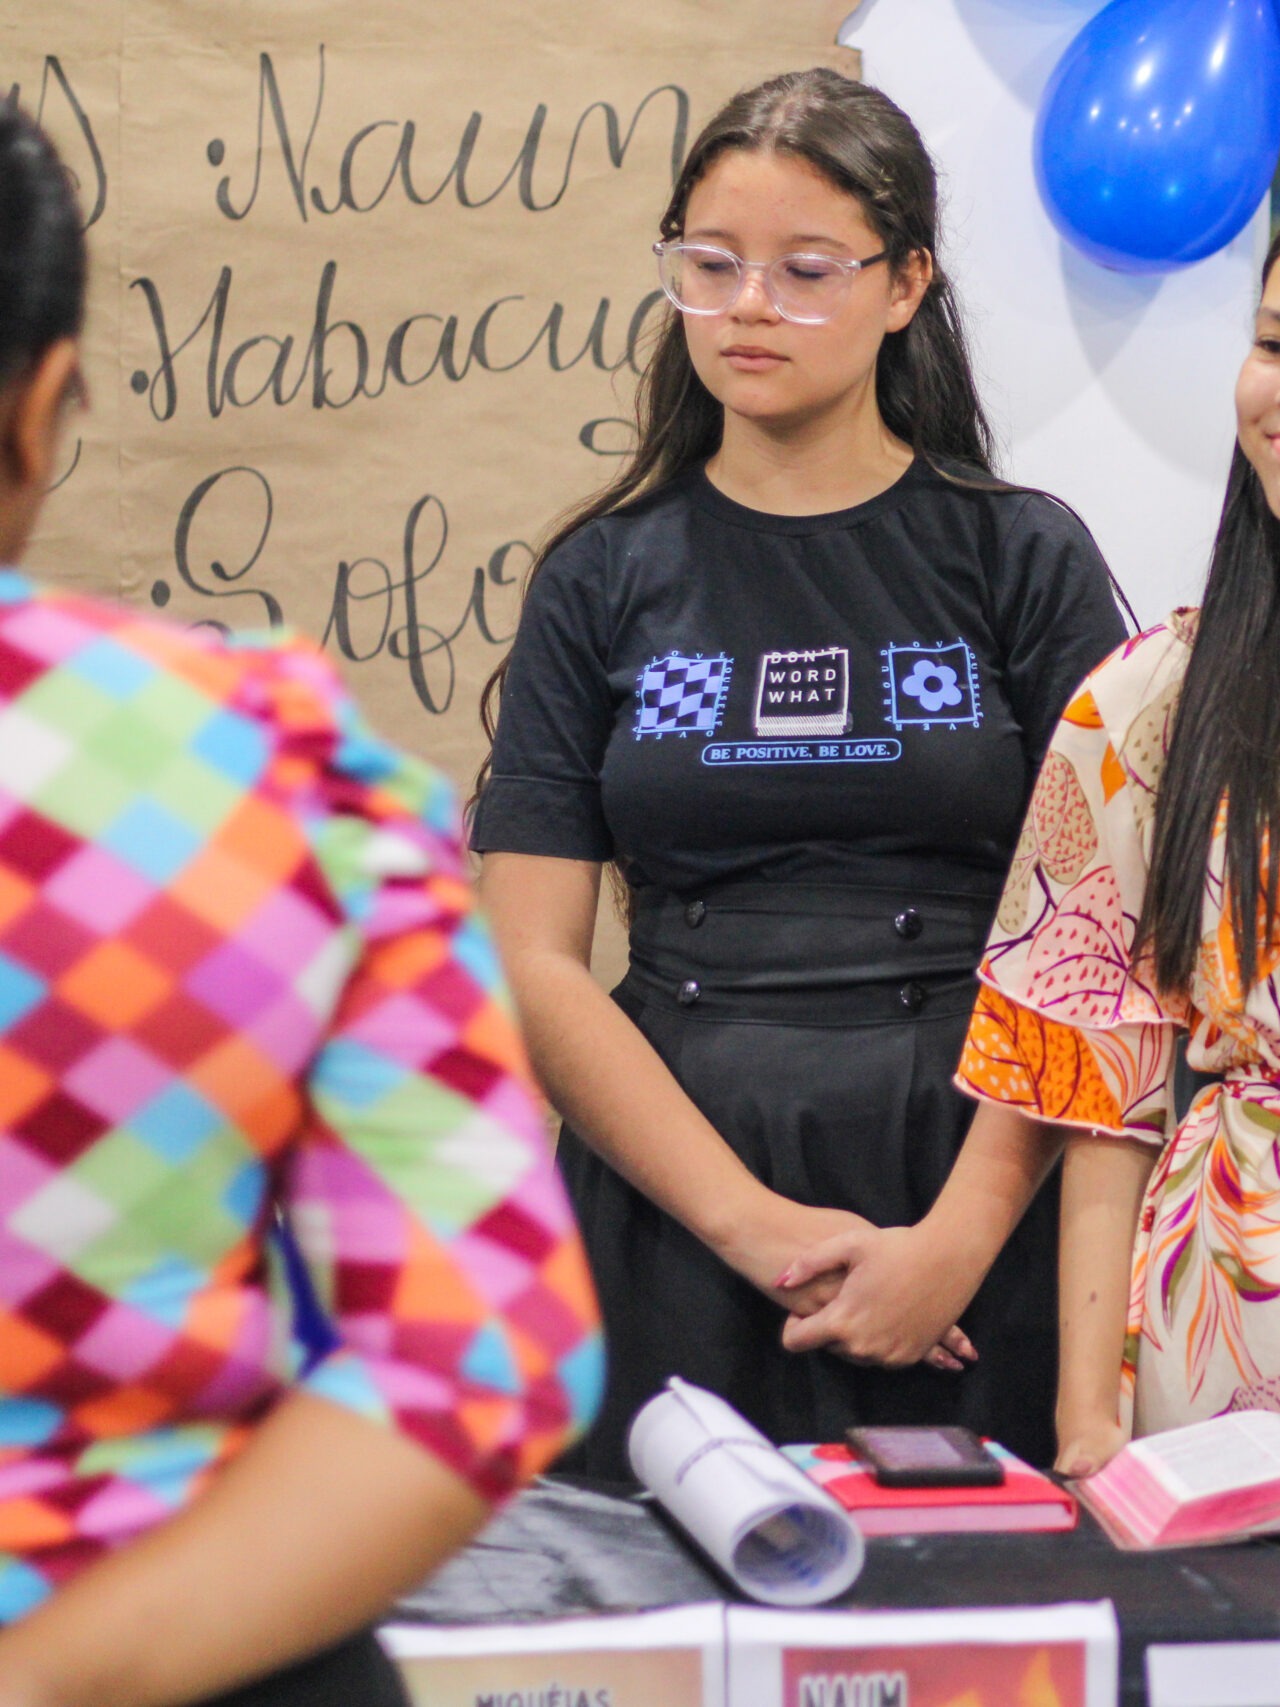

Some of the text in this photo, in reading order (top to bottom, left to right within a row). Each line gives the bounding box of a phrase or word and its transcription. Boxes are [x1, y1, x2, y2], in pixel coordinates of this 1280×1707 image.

[770, 646, 840, 664] DON'T
[770, 668, 837, 684] WORD
[967, 645, 984, 718] OURSELF
[768, 688, 836, 703] WHAT
[711, 744, 890, 760] BE POSITIVE, BE LOVE.
